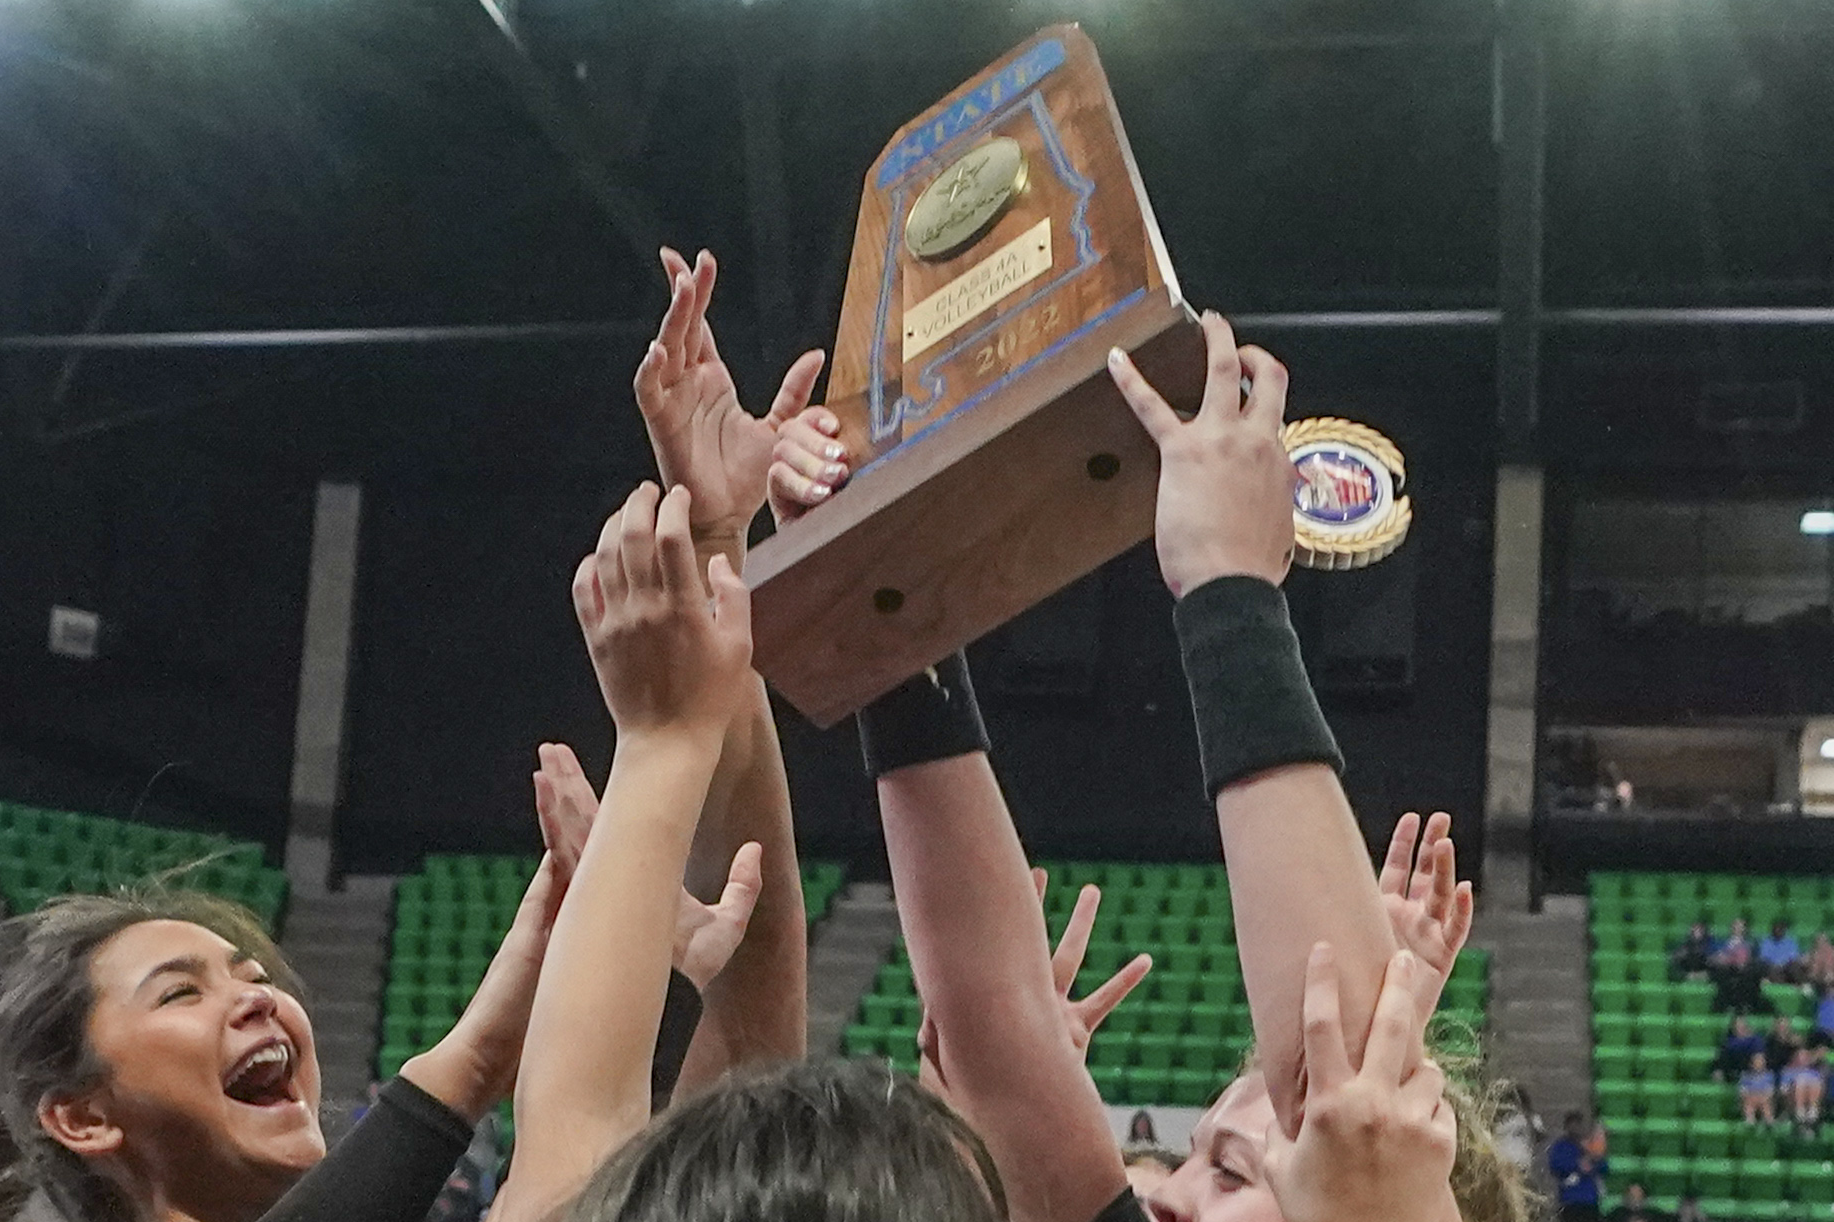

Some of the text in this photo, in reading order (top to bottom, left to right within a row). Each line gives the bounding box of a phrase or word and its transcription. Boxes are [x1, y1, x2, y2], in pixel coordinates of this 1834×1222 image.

[898, 55, 1043, 171] STATE
[923, 260, 1029, 339] VOLLEYBALL
[935, 251, 1018, 312] CLASS 4A
[975, 303, 1060, 376] 2022
